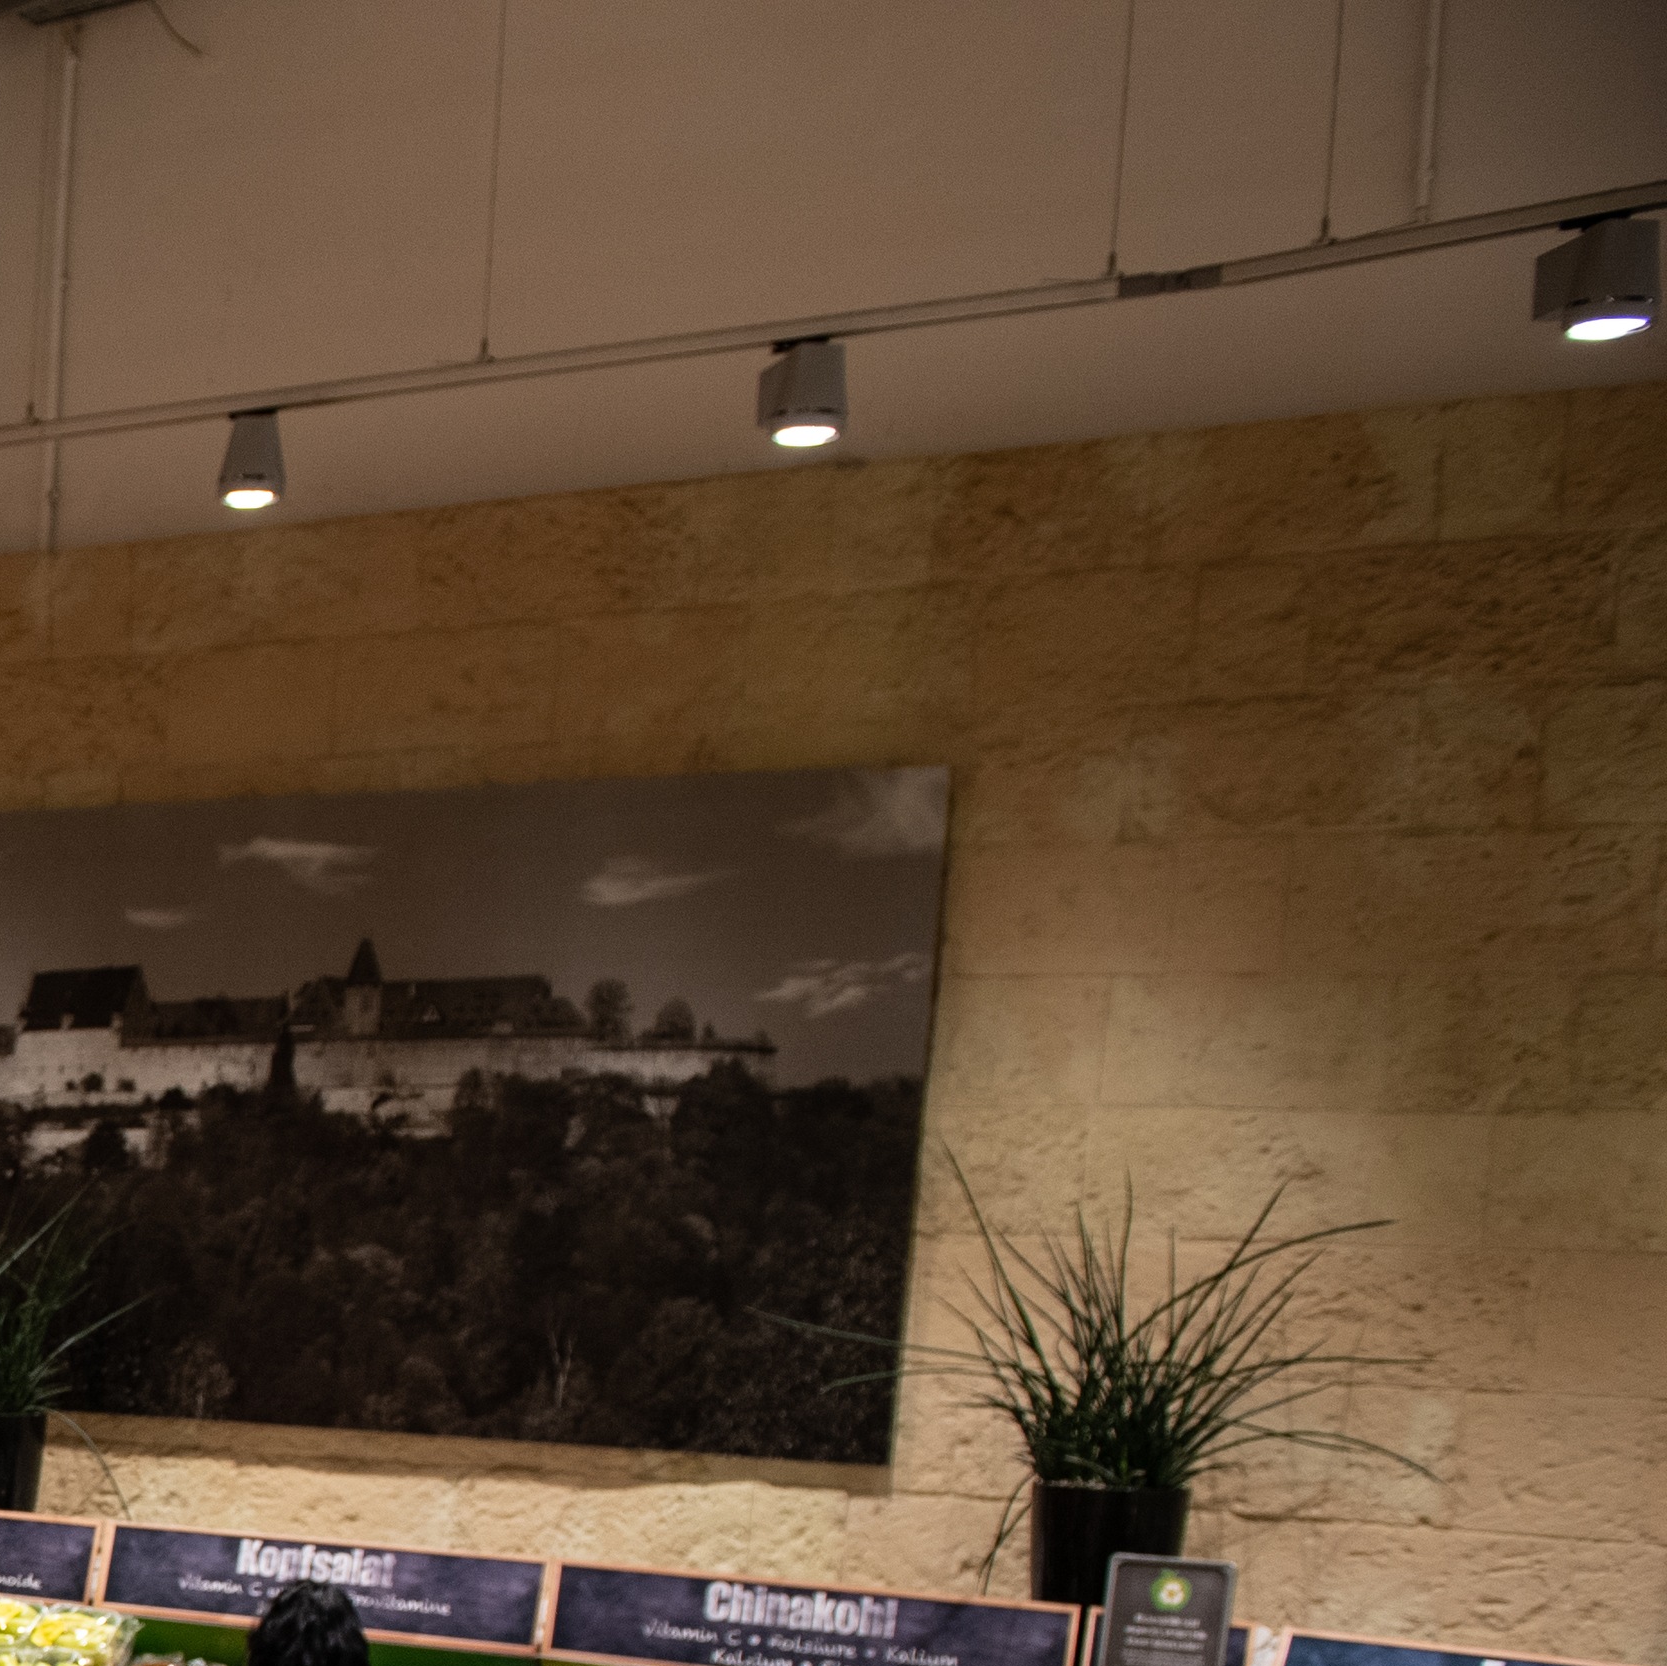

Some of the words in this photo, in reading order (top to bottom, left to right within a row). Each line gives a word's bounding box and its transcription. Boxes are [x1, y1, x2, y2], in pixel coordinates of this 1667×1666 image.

[236, 1538, 396, 1588] Kopfsalat
[178, 1574, 243, 1595] Vitamin
[248, 1581, 263, 1598] C
[704, 1581, 897, 1639] Chinakohl
[642, 1620, 718, 1643] Vitamin
[726, 1629, 740, 1645] C
